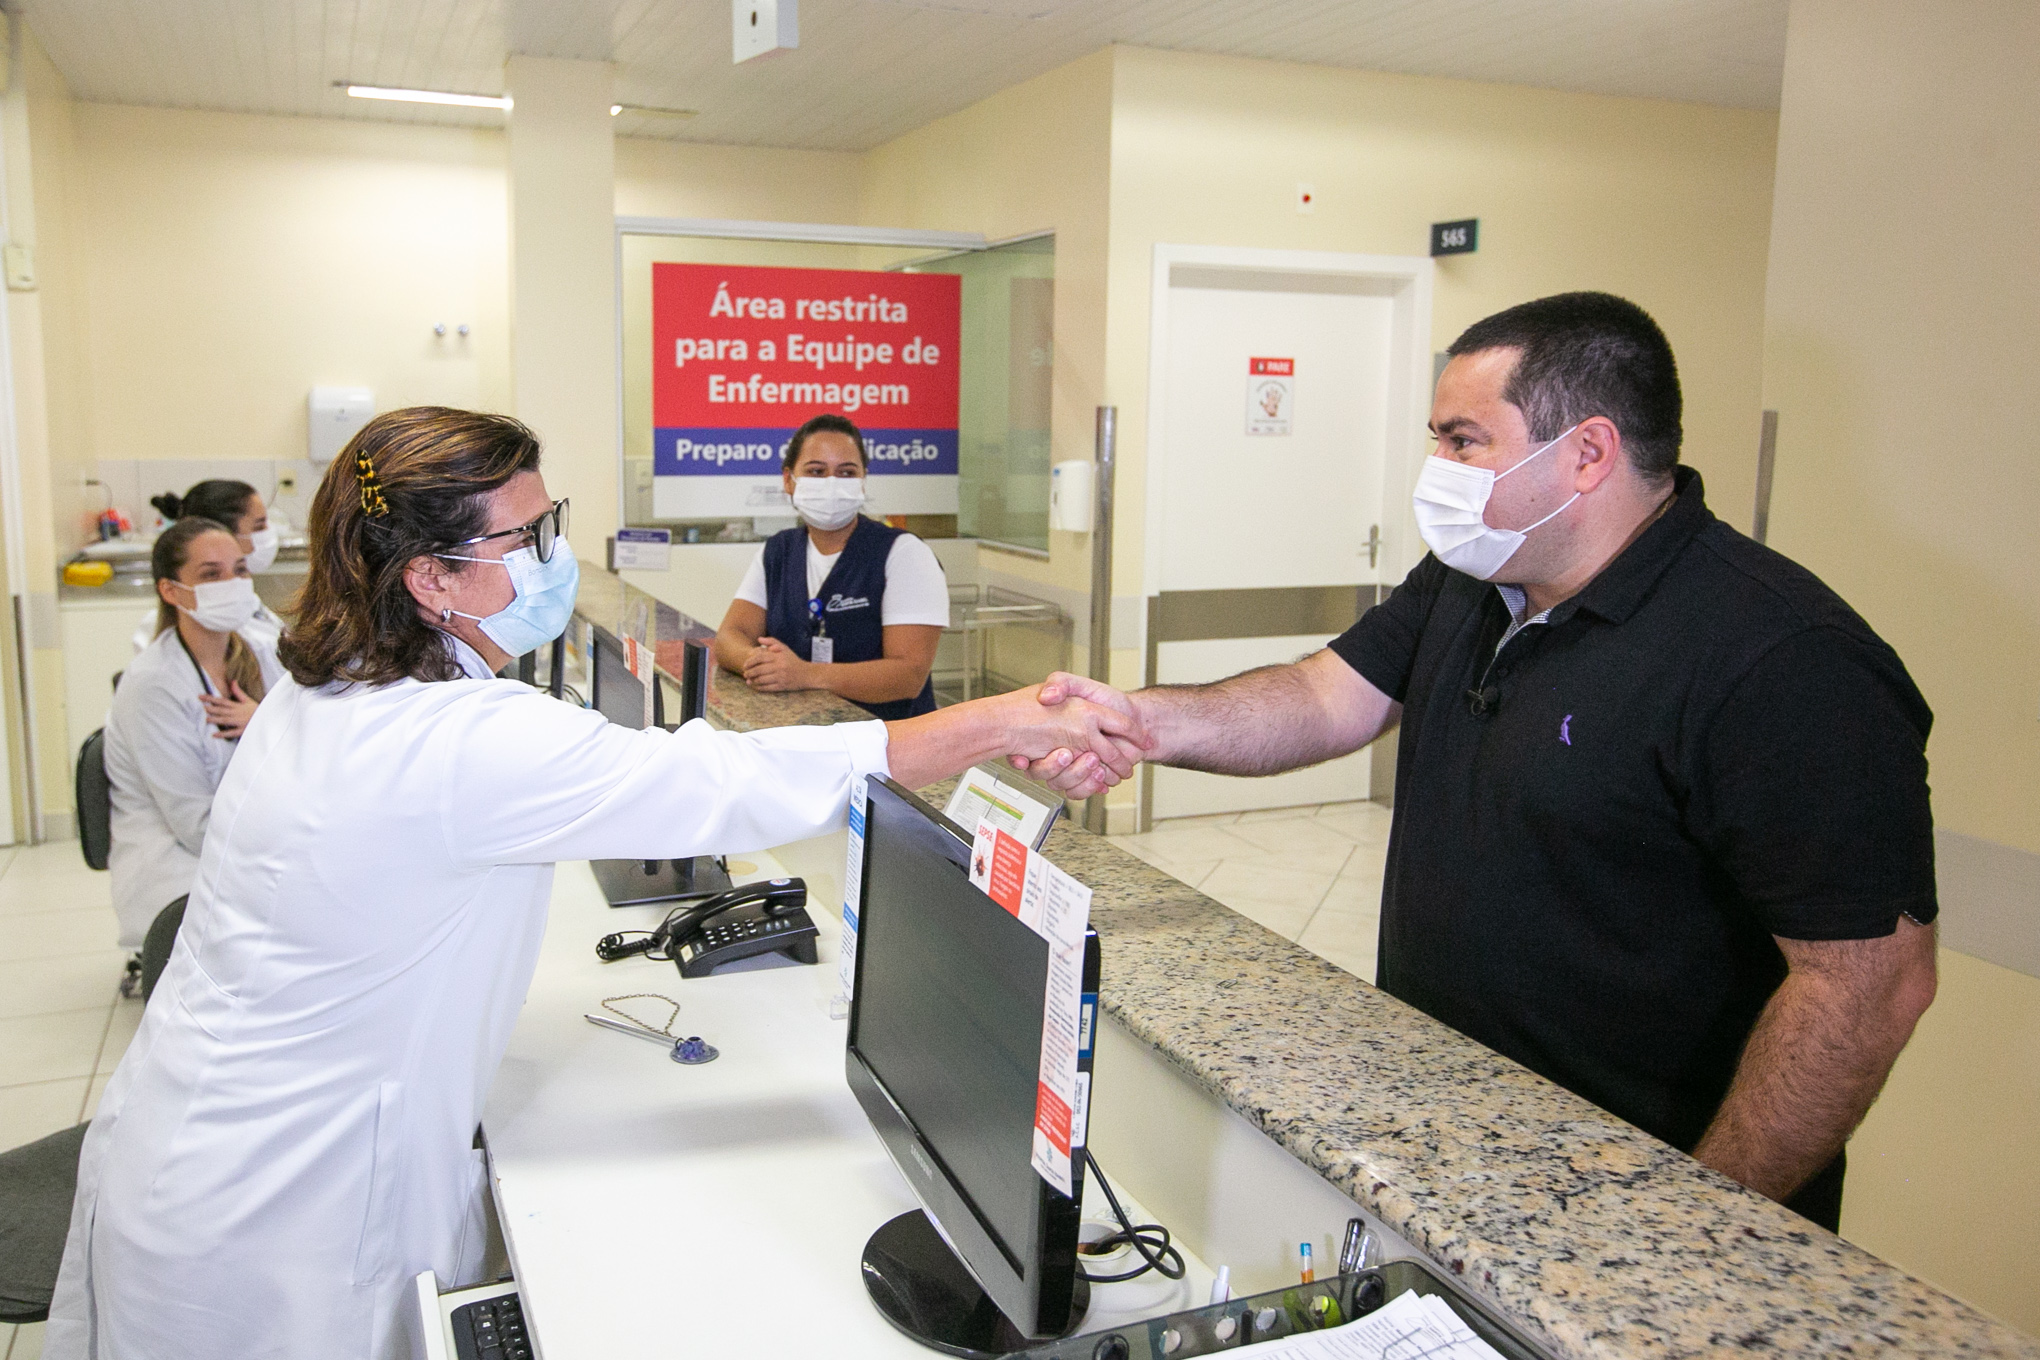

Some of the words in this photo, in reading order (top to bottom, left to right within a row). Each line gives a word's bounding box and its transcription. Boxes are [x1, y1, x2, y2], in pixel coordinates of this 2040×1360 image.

[709, 281, 786, 319] Área
[796, 294, 908, 323] restrita
[675, 338, 749, 368] para
[758, 339, 776, 361] a
[787, 334, 894, 371] Equipe
[902, 336, 940, 364] de
[708, 374, 910, 412] Enfermagem
[675, 438, 773, 466] Preparo
[862, 438, 939, 466] icação
[978, 824, 994, 842] SEPSE
